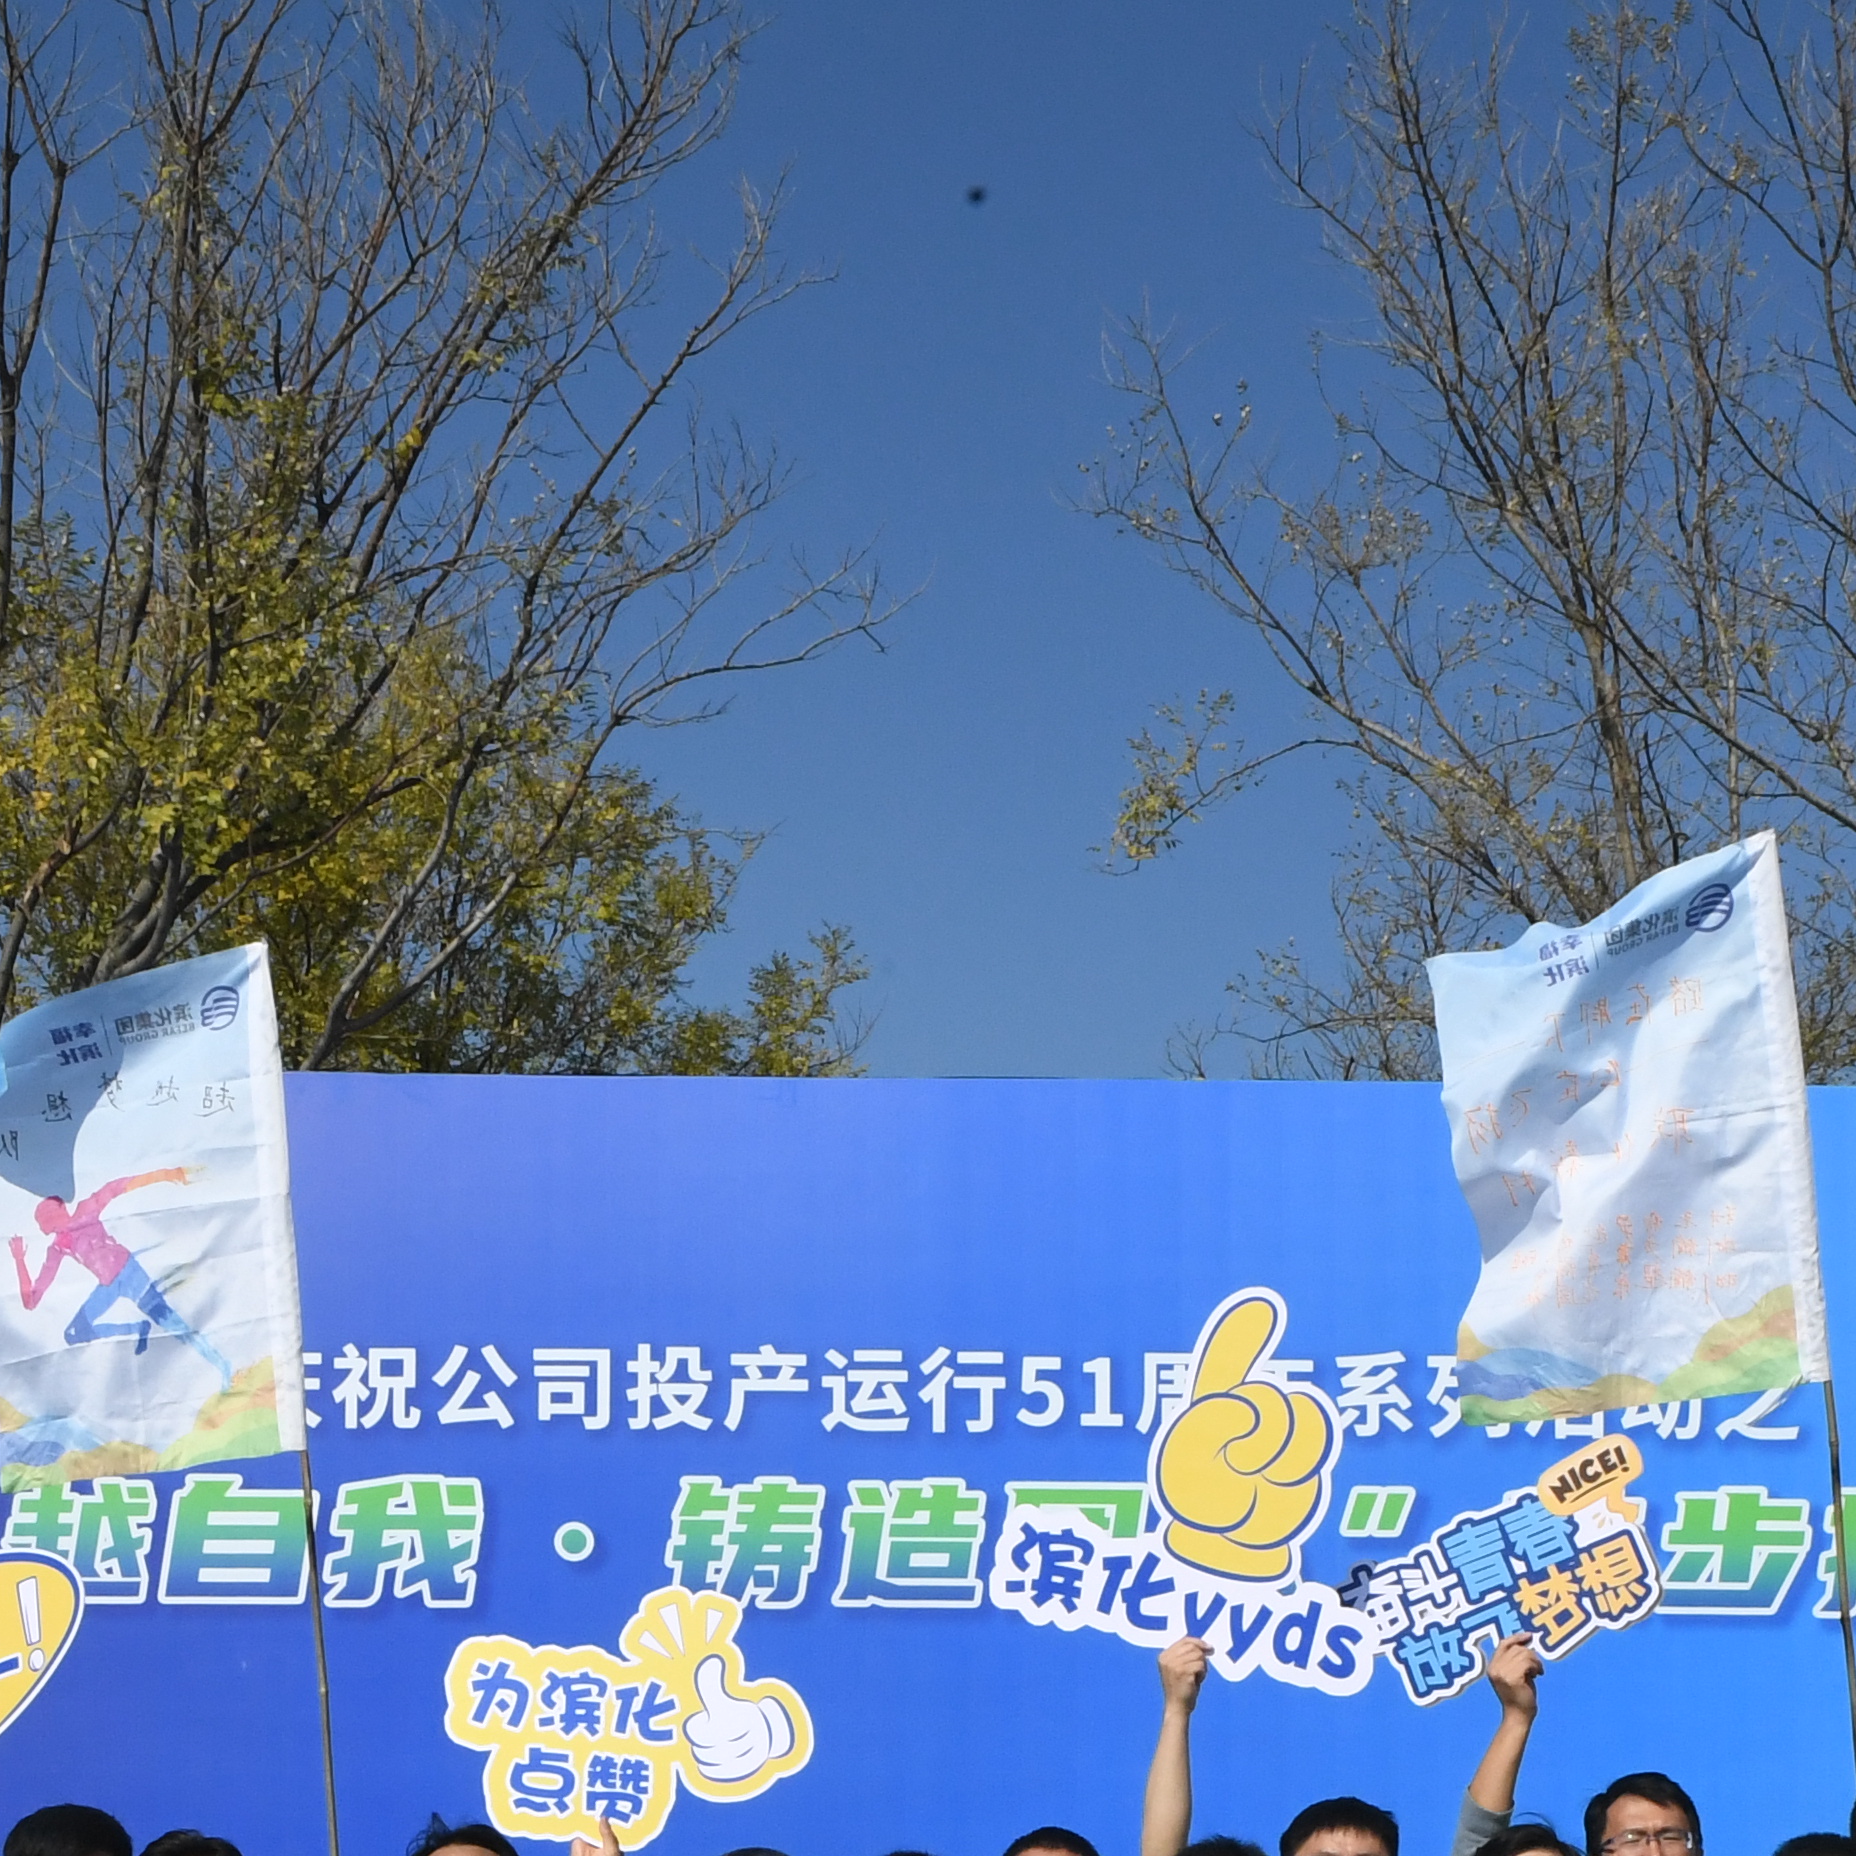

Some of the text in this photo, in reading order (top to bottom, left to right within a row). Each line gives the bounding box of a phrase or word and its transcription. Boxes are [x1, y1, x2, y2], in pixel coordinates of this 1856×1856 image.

[301, 1342, 1801, 1442] 祝公司投产运行51系之
[1548, 1445, 1630, 1504] NICE!
[1004, 1521, 1364, 1679] 滨化yyds
[470, 1661, 679, 1744] 为滨化
[508, 1749, 652, 1826] 点赞
